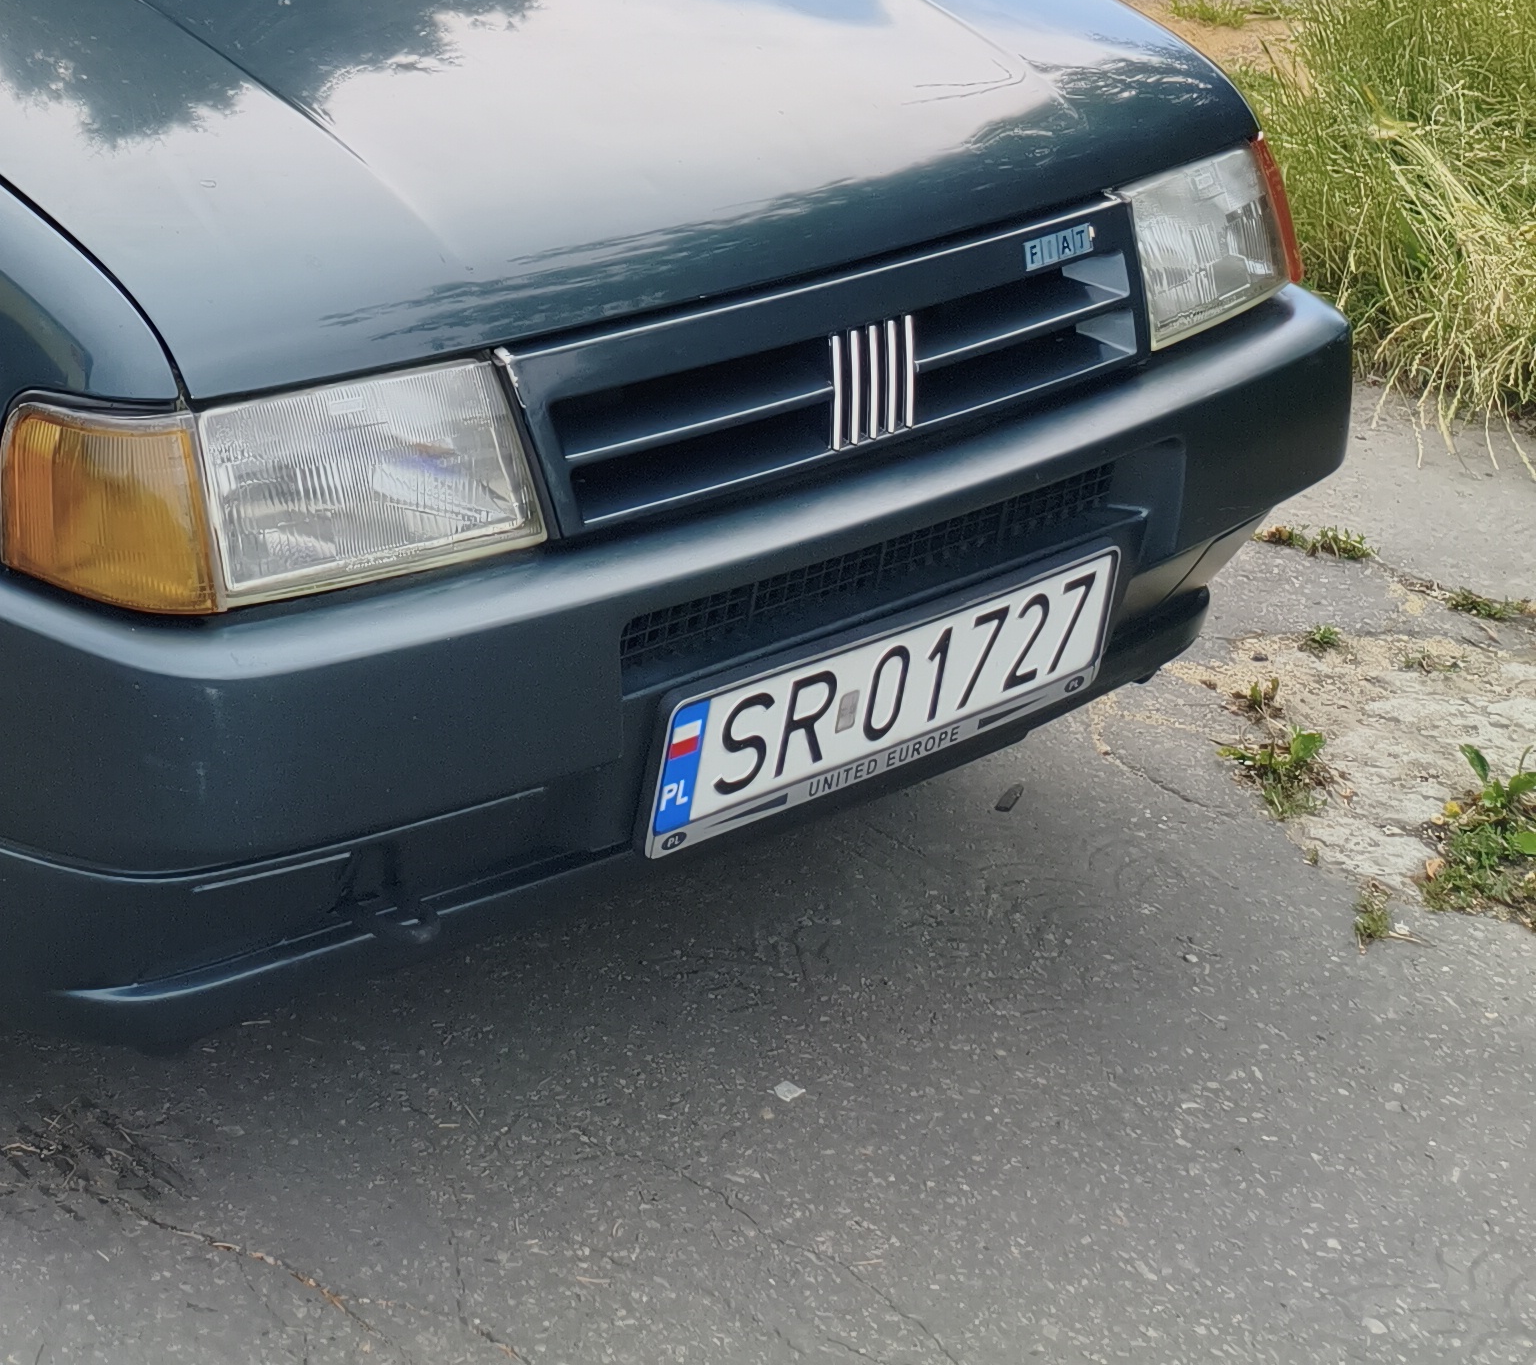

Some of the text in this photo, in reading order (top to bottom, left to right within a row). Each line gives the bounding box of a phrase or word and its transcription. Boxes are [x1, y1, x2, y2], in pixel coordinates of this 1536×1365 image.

[1028, 228, 1086, 266] FIAT
[713, 571, 1097, 796] SR 01727
[808, 725, 962, 797] UNITED EUROPE
[659, 778, 689, 812] PL
[667, 835, 681, 848] PL
